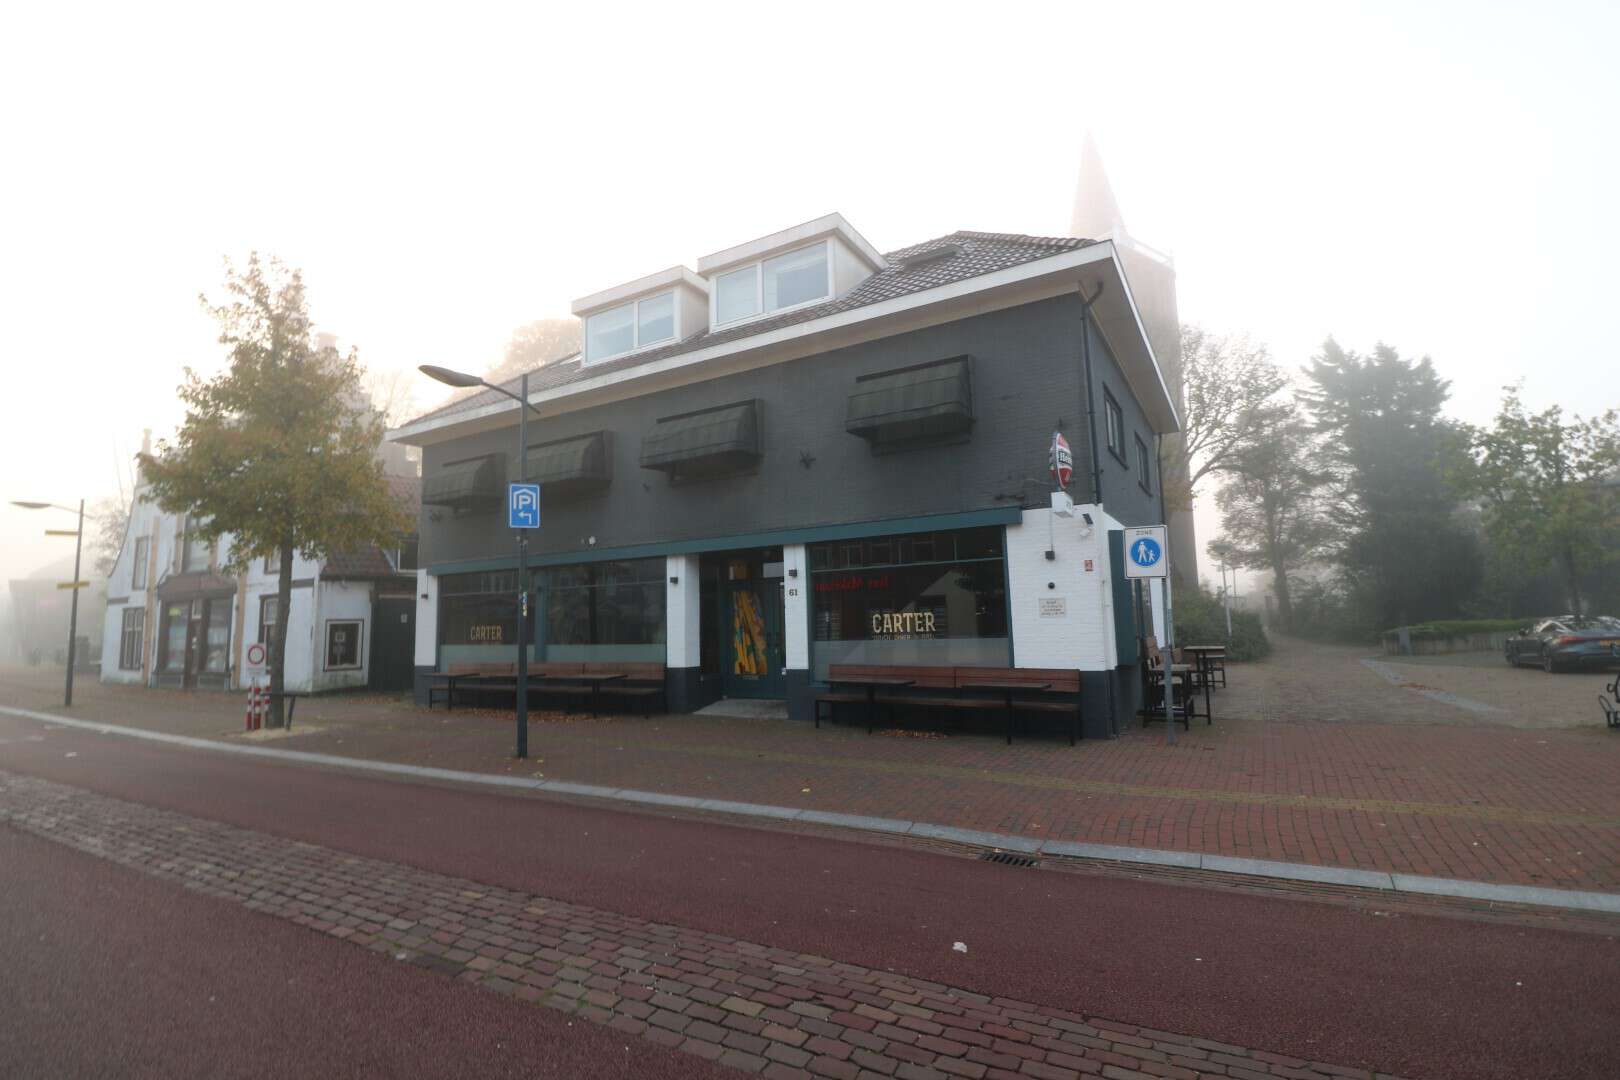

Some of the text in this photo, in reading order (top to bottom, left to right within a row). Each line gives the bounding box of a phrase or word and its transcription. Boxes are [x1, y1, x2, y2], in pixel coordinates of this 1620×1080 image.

[519, 495, 531, 510] P
[789, 589, 799, 597] 61
[872, 612, 936, 633] CARTER
[470, 626, 502, 641] CARTER
